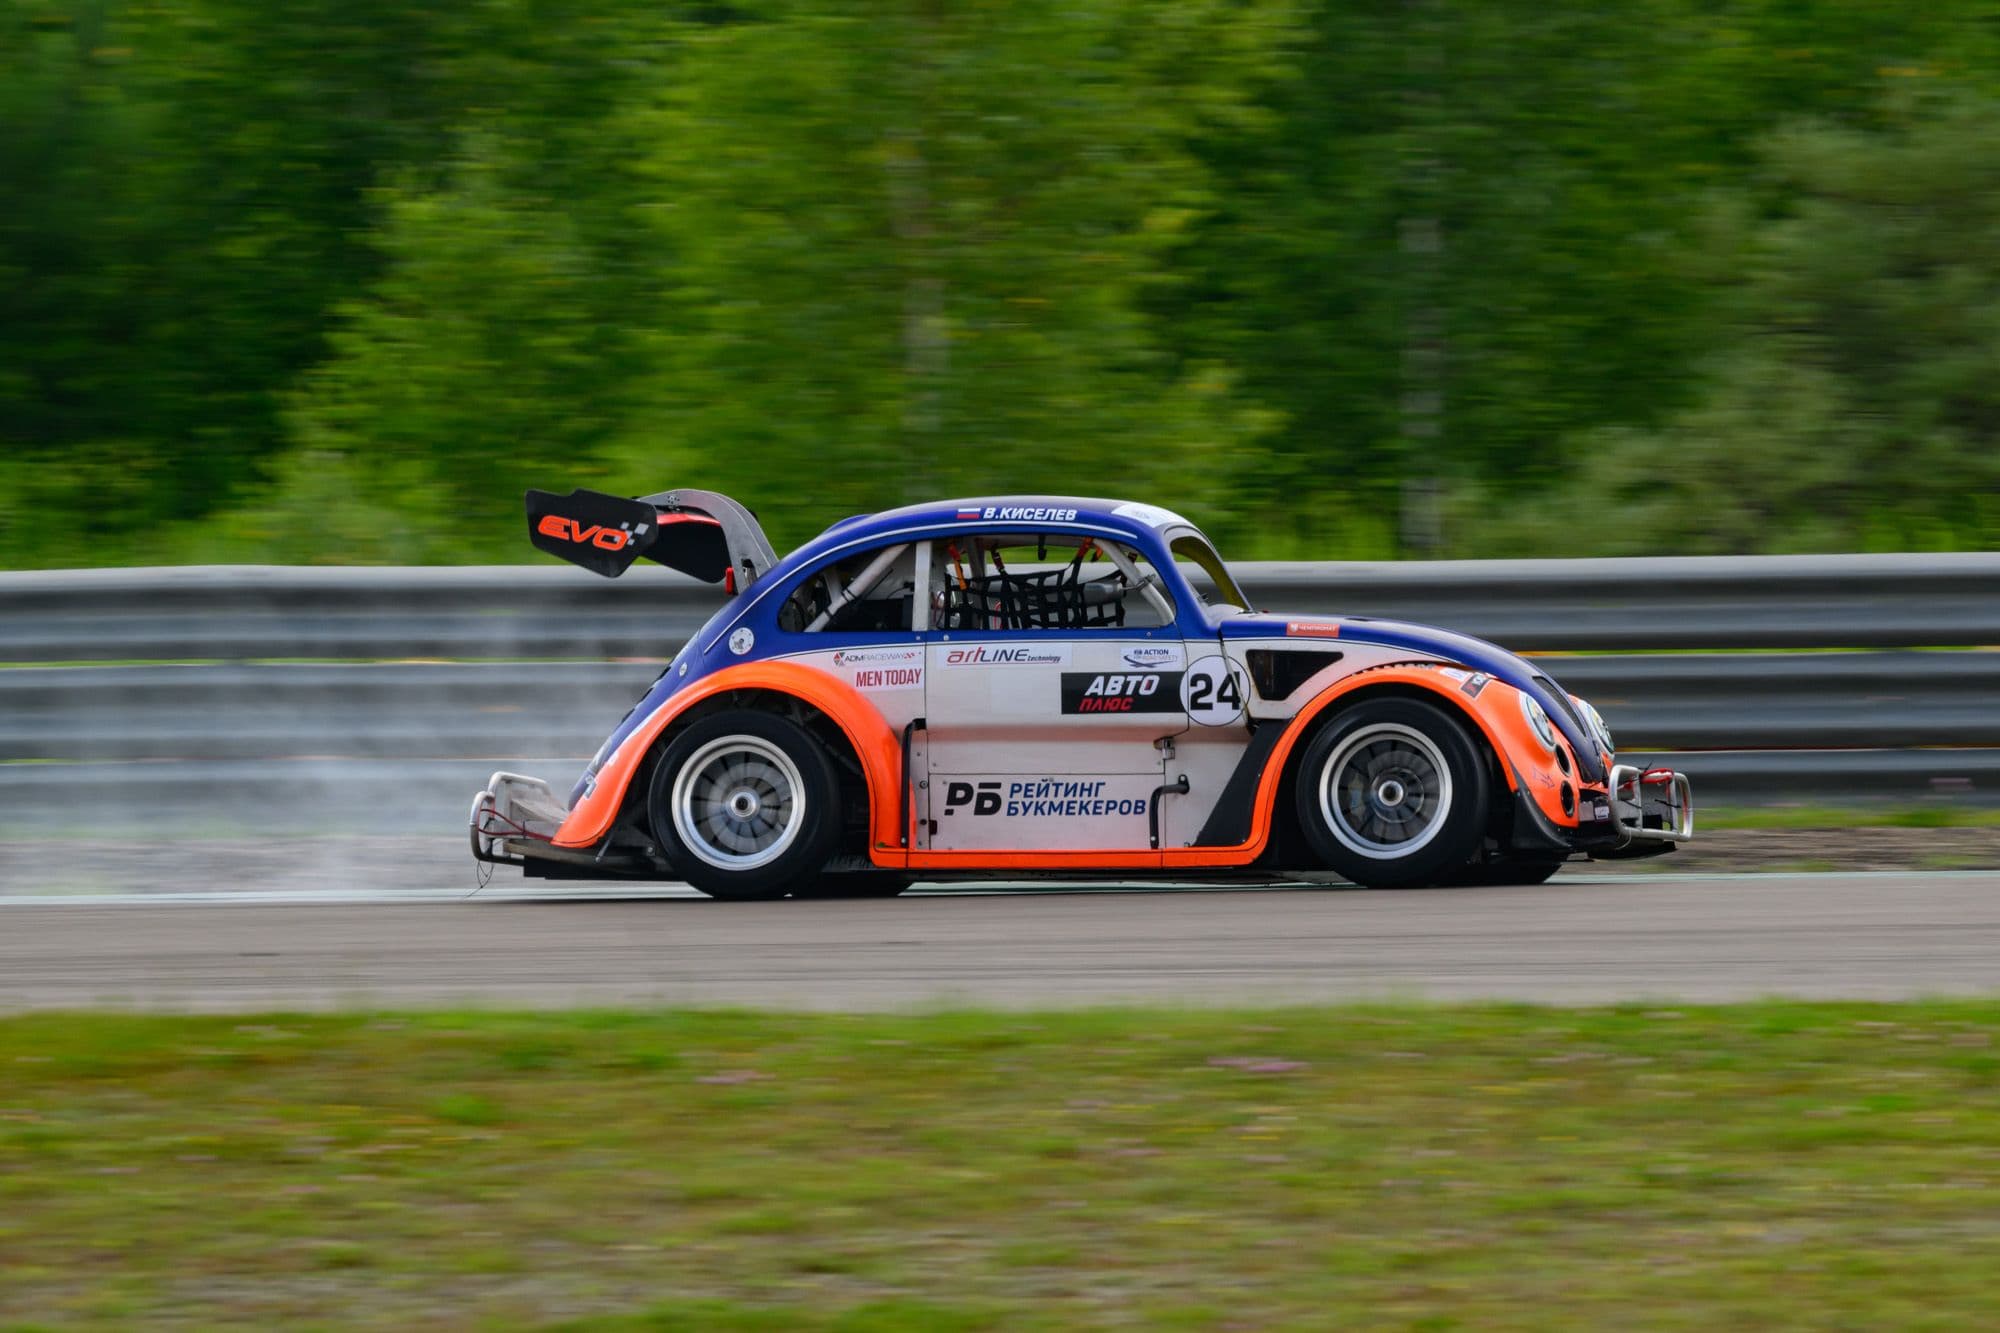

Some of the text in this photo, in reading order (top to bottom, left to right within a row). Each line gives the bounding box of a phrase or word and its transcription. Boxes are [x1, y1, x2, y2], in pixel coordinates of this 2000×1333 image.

[983, 507, 1077, 520] В.КИСЕЛЕВ
[538, 515, 628, 551] EVO
[856, 668, 922, 687] MEN TODAY
[1085, 675, 1160, 696] АВТО
[1189, 672, 1240, 710] 24
[1079, 698, 1133, 712] ПЛЮС
[1009, 778, 1106, 798] РЕЙТИНГ
[1006, 800, 1146, 817] БУКМЕКЕРОВ
